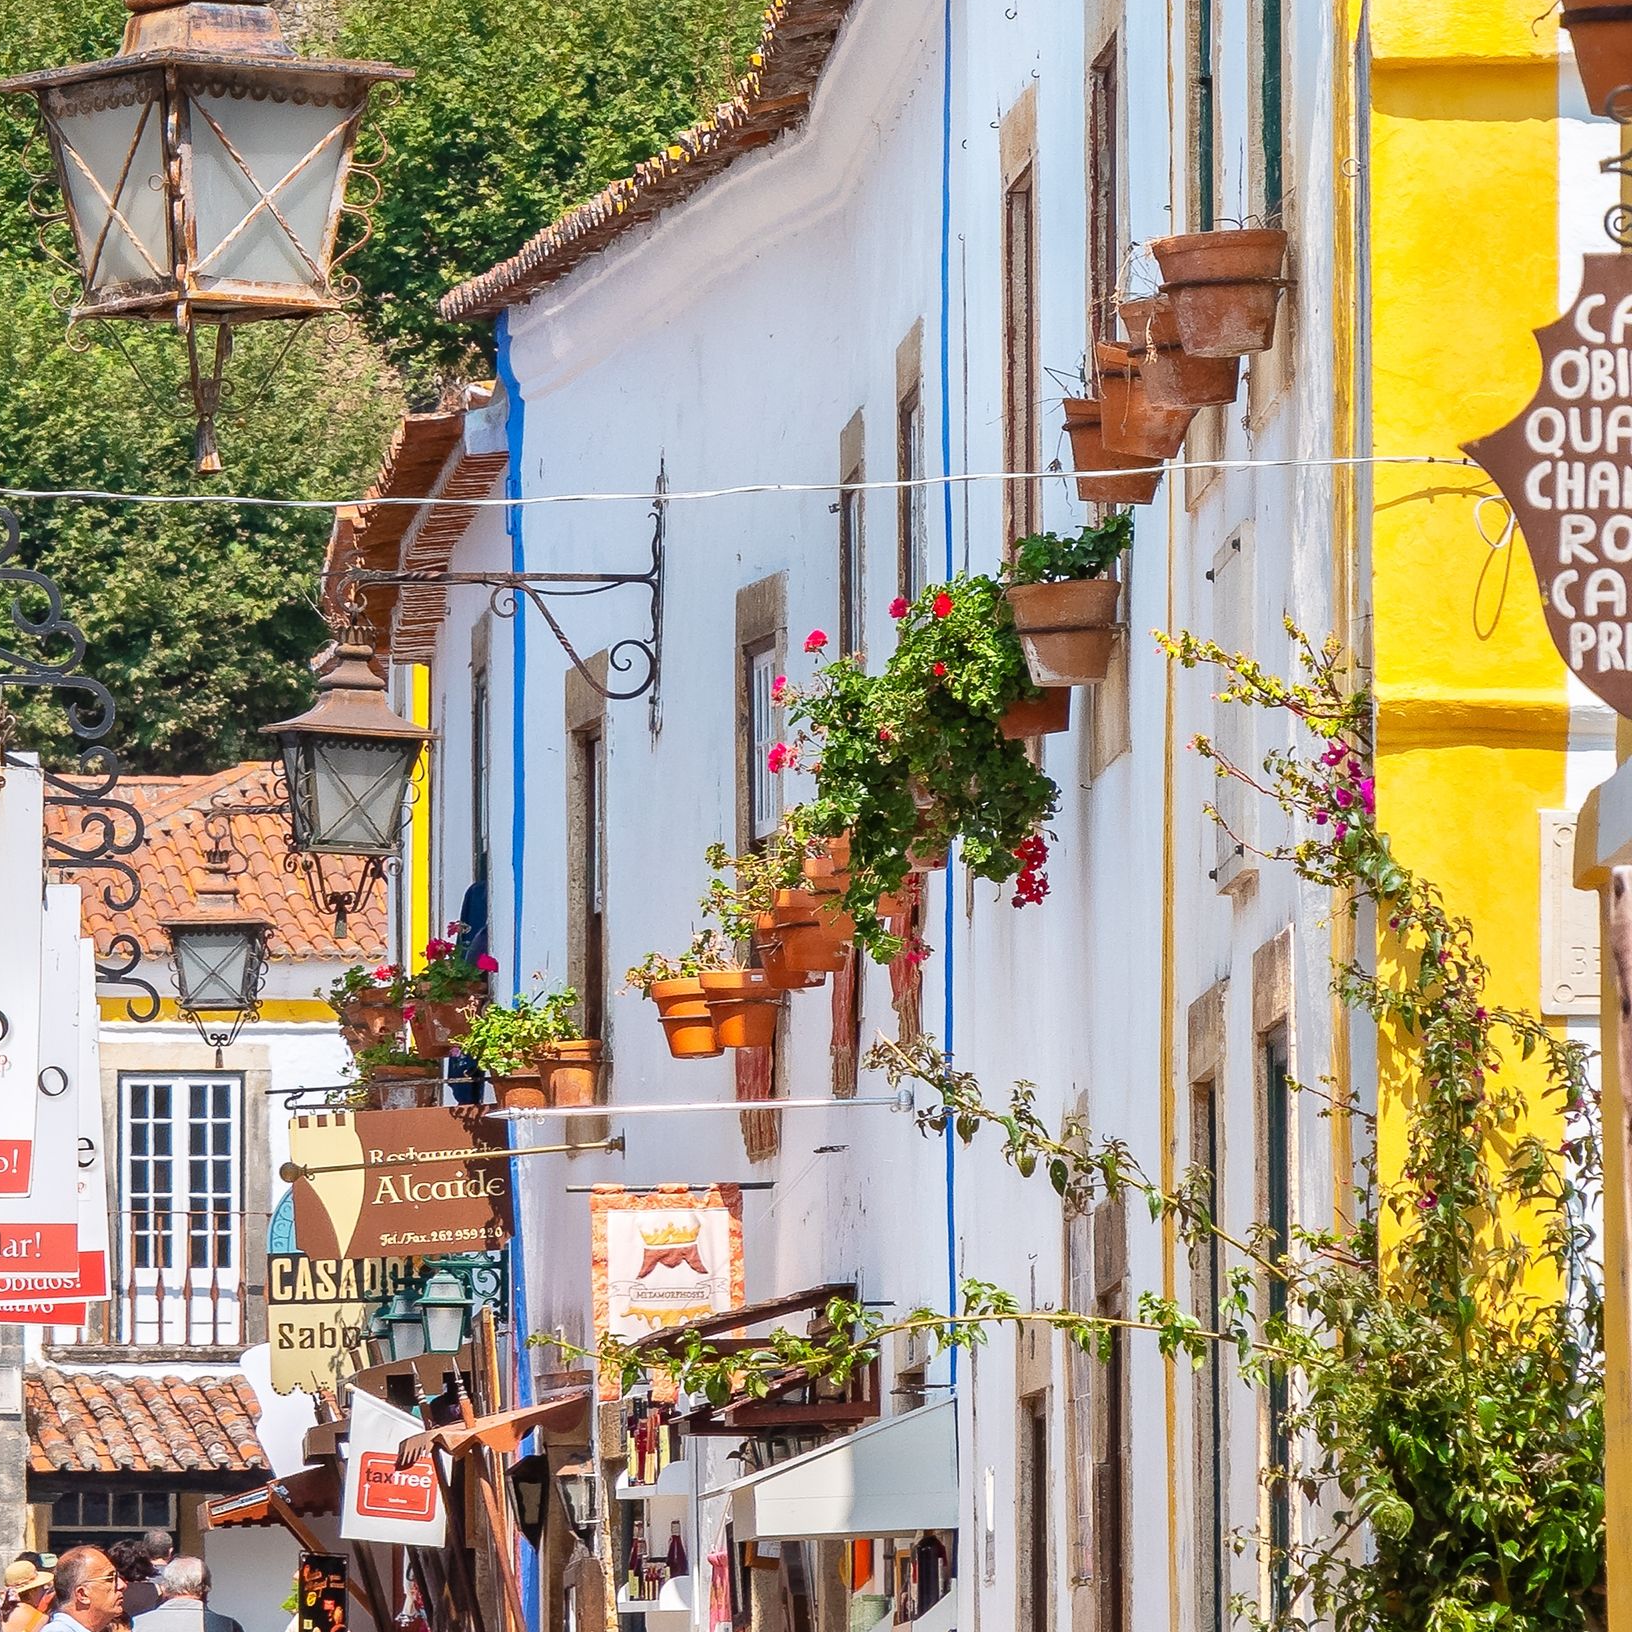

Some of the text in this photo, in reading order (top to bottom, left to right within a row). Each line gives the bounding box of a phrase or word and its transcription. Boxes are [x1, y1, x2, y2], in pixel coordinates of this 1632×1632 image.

[1549, 345, 1632, 402] ÓBI
[1524, 459, 1632, 511] CHA
[371, 1169, 506, 1206] Alcaide
[271, 1256, 359, 1301] CASA
[365, 1467, 433, 1489] taxfree
